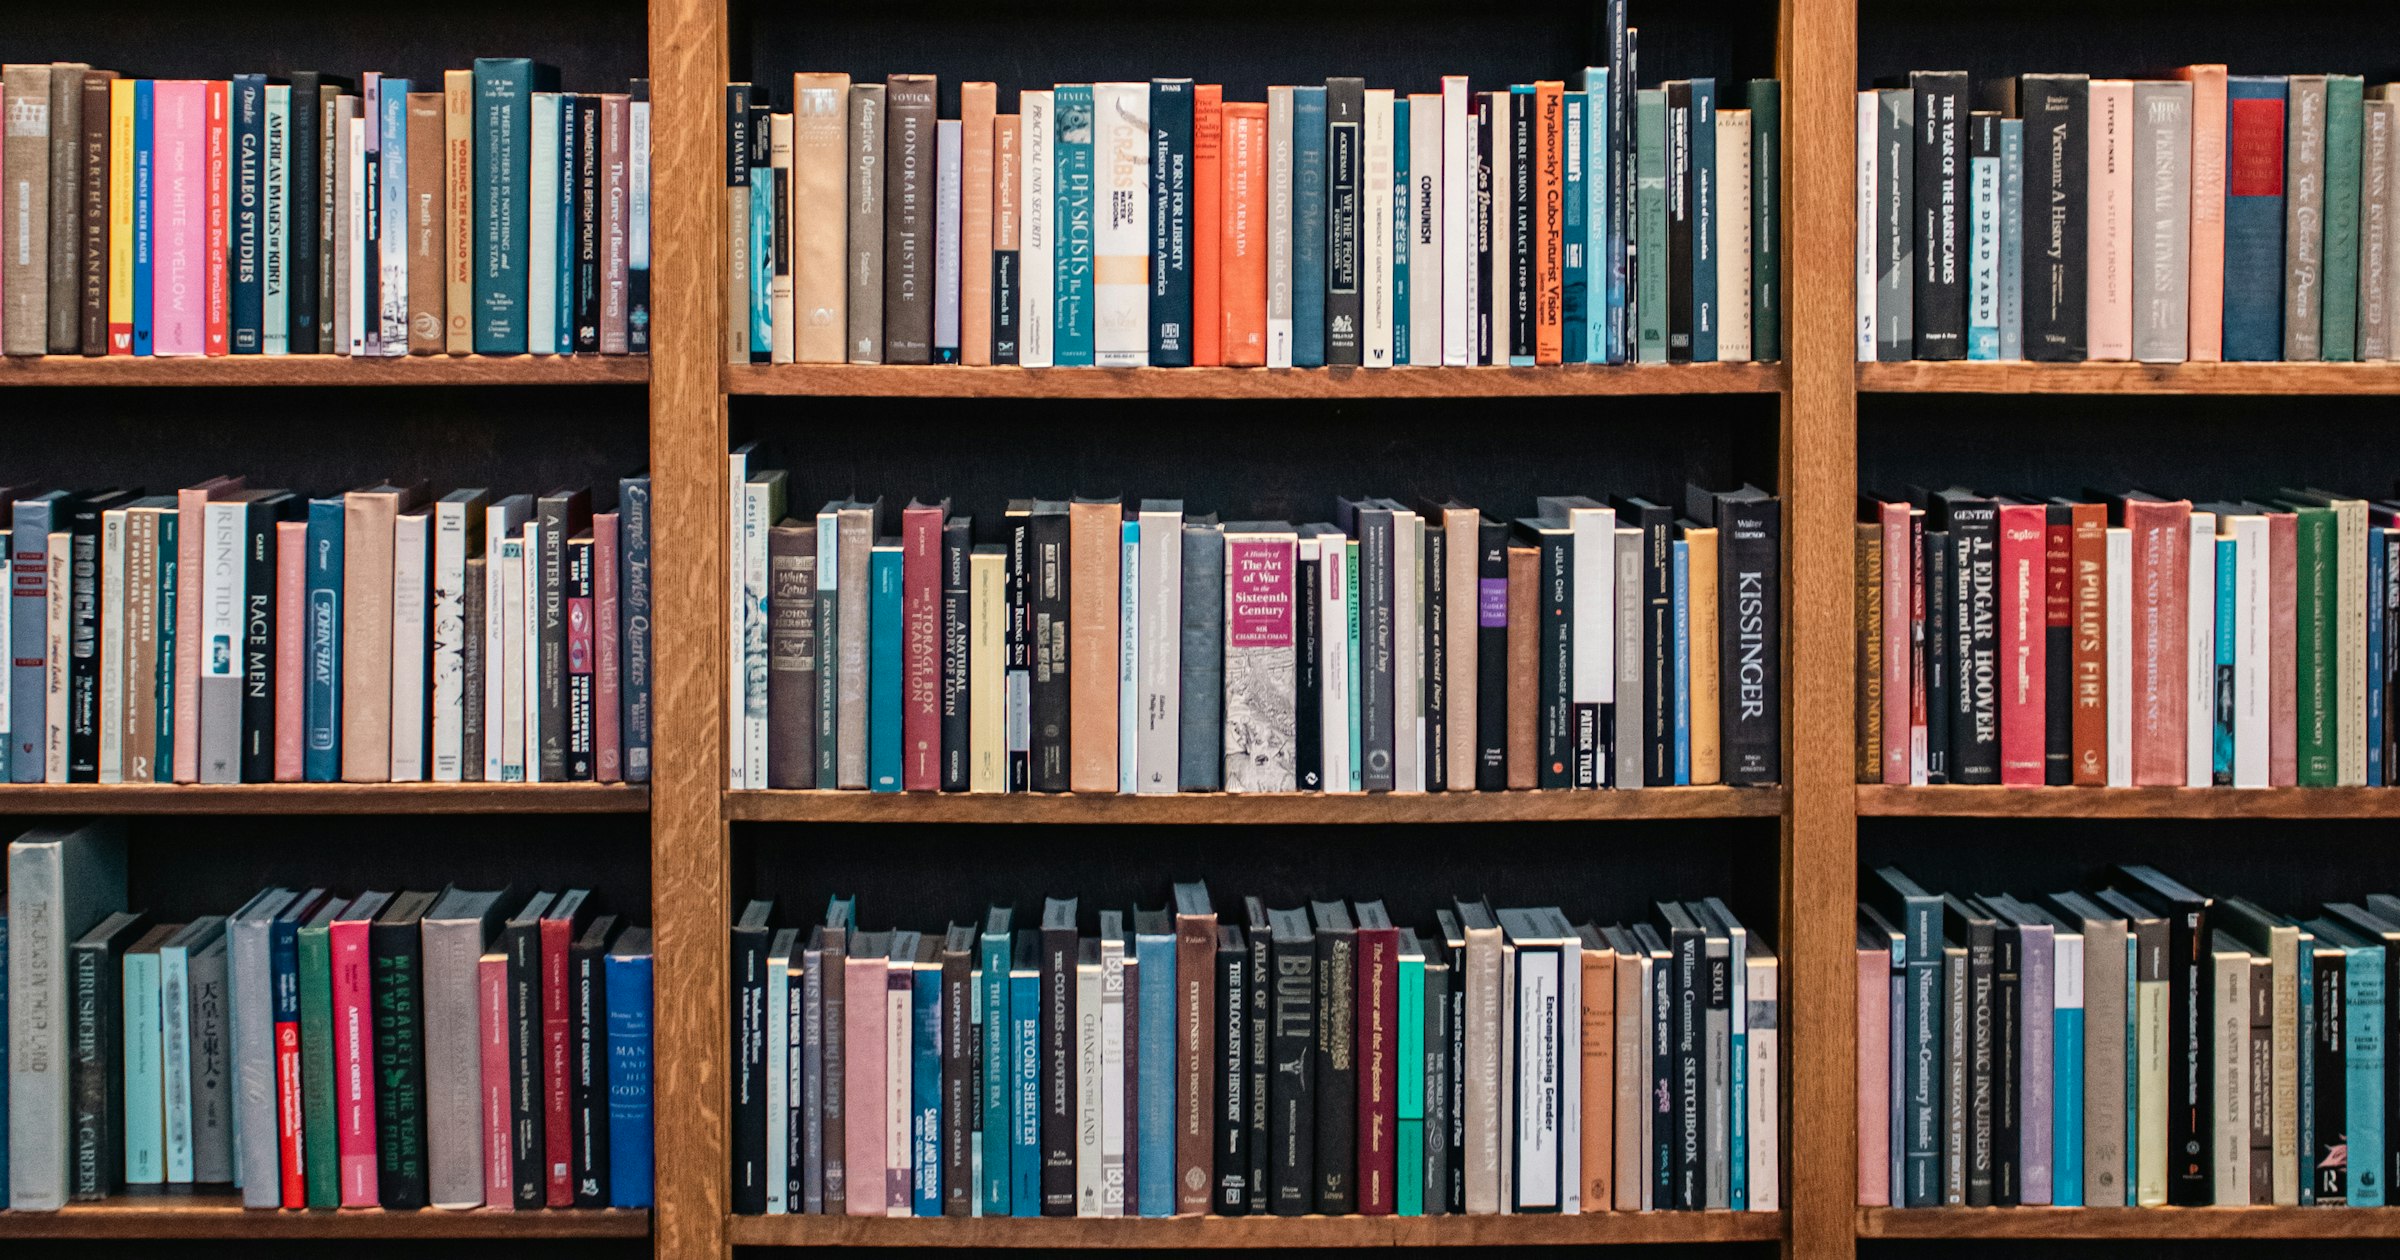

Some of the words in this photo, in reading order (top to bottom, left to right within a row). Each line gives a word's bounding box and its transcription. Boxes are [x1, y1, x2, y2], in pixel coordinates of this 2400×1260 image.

[244, 87, 255, 123] Drake
[861, 99, 875, 152] Adaptive
[1943, 95, 1954, 120] THE
[584, 109, 594, 175] FUNDAMENTALS
[1003, 129, 1012, 148] The
[1032, 105, 1042, 163] PRACTICAL
[1943, 123, 1954, 156] YEAR
[241, 133, 256, 206] GALILEO
[611, 162, 623, 184] The
[903, 117, 916, 224] HONORABLE
[1113, 127, 1134, 187] CRABS
[1173, 154, 1183, 189] BORN
[1518, 121, 1527, 202] PIERRE-SIMON
[1943, 158, 1954, 176] OF
[2052, 123, 2066, 188] Vietnam:
[2155, 129, 2174, 211] PERSONAL
[88, 143, 101, 217] EARTH'S
[584, 179, 593, 187] IN
[861, 156, 875, 214] Dynamics
[1000, 152, 1012, 207] Ecological
[1032, 166, 1041, 195] UNIX
[1128, 191, 1133, 199] IN
[1943, 179, 1954, 203] THE
[1982, 165, 1991, 202] THE
[2053, 190, 2066, 203] A
[421, 194, 432, 225] Death
[584, 190, 593, 221] BRITISH
[611, 187, 622, 220] Curve
[1032, 198, 1041, 249] SECURITY
[1173, 193, 1183, 216] FOR
[1343, 194, 1353, 211] WE
[1421, 176, 1431, 244] COMMUNISM
[419, 228, 431, 256] Song
[583, 224, 592, 259] POLITICS
[611, 223, 622, 236] of
[1002, 211, 1011, 245] Indian
[1172, 219, 1182, 270] LIBERTY
[1343, 213, 1352, 238] THE
[1518, 206, 1527, 254] LAPLACE
[1942, 206, 1954, 284] BARRICADES
[1981, 211, 1990, 260] DEAD
[2048, 206, 2065, 258] History
[88, 226, 100, 308] BLANKET
[241, 212, 255, 282] STUDIES
[607, 237, 622, 279] Binding
[901, 232, 915, 302] JUSTICE
[1343, 241, 1352, 282] PEOPLE
[2155, 219, 2173, 291] WITNESS
[608, 281, 622, 317] Energy
[1981, 268, 1990, 320] YARD
[547, 515, 559, 526] A
[747, 496, 758, 538] design
[1954, 509, 1995, 521] GENTRY
[217, 510, 232, 576] RISING
[547, 531, 559, 587] BETTER
[1015, 526, 1024, 576] WARRIORS
[1125, 545, 1135, 582] Bushido
[1251, 551, 1270, 559] History
[1555, 545, 1564, 576] JULIA
[1958, 537, 1970, 564] The
[1973, 537, 1991, 554] J.
[131, 542, 139, 602] POLITICAL
[571, 561, 579, 580] KIM
[580, 546, 589, 596] YOUNG-HA
[951, 548, 961, 585] JANSON
[1016, 579, 1023, 587] OF
[1241, 560, 1265, 571] The
[1267, 560, 1281, 571] Art
[1243, 571, 1254, 583] of
[1259, 571, 1280, 583] War
[1959, 567, 1970, 600] Man
[216, 584, 231, 627] TIDE
[547, 591, 559, 628] IDEA
[1125, 585, 1135, 601] and
[1235, 593, 1288, 603] Sixteenth
[1239, 604, 1285, 619] Century
[1555, 579, 1564, 602] CHO
[1973, 561, 1994, 640] EDGAR
[2018, 559, 2029, 640] Middletown
[2080, 560, 2101, 651] APOLLO'S
[142, 583, 150, 641] THEORIZE
[251, 594, 266, 645] RACE
[945, 599, 956, 653] HISTORY
[956, 622, 966, 631] A
[1015, 607, 1024, 641] RISING
[1125, 605, 1135, 622] the
[1125, 625, 1134, 639] Art
[1559, 623, 1567, 640] THE
[1959, 604, 1971, 630] and
[911, 611, 923, 701] TRADITION
[922, 606, 934, 675] STORAGE
[1015, 644, 1024, 665] SUN
[1125, 642, 1134, 651] of
[1740, 572, 1763, 722] KISSINGER
[1959, 634, 1971, 657] the
[250, 652, 266, 697] MEN
[945, 658, 956, 675] OF
[956, 634, 966, 692] NATURAL
[1122, 654, 1134, 682] Living
[1559, 643, 1567, 693] LANGUAGE
[2018, 646, 2029, 704] Families
[922, 682, 934, 714] BOX
[945, 678, 956, 716] LATIN
[1959, 659, 1972, 712] Secrets
[1975, 650, 1994, 743] HOOVER
[2080, 662, 2100, 708] FIRE
[1558, 696, 1566, 736] ARCHIVE
[1580, 709, 1592, 750] PATRICK
[1580, 753, 1592, 783] TYLER
[1229, 962, 1241, 986] THE
[1255, 941, 1266, 982] ATLAS
[1682, 939, 1696, 988] William
[1254, 991, 1266, 1009] OF
[1276, 955, 1312, 1037] BULL!
[1712, 962, 1724, 1004] SEOUL
[1977, 974, 1992, 1003] The
[78, 953, 94, 1065] KHRUSHCHEV
[396, 956, 414, 1065] MARGARET
[952, 982, 961, 1058] KLOPPENBERG
[1229, 988, 1241, 1057] HOLOCAUST
[1681, 990, 1696, 1051] Cumming
[1024, 1019, 1036, 1079] BEYOND
[1253, 1019, 1266, 1064] JEWISH
[1543, 996, 1556, 1083] Encompassing
[1916, 968, 1933, 1104] Nineteenth-Century
[1977, 1005, 1990, 1070] COSMIC
[1229, 1060, 1240, 1072] IN
[79, 1110, 93, 1123] A
[1024, 1082, 1036, 1146] SHELTER
[1228, 1073, 1240, 1122] HISTORY
[1254, 1073, 1265, 1131] HISTORY
[1544, 1088, 1555, 1131] Gender
[1684, 1057, 1697, 1163] SKETCHBOOK
[924, 1108, 937, 1141] SAUDIS
[1918, 1107, 1932, 1149] Music
[1976, 1075, 1990, 1170] INQUIRERS
[79, 1126, 95, 1193] CAREER
[924, 1143, 937, 1162] AND
[924, 1163, 937, 1199] TERROR
